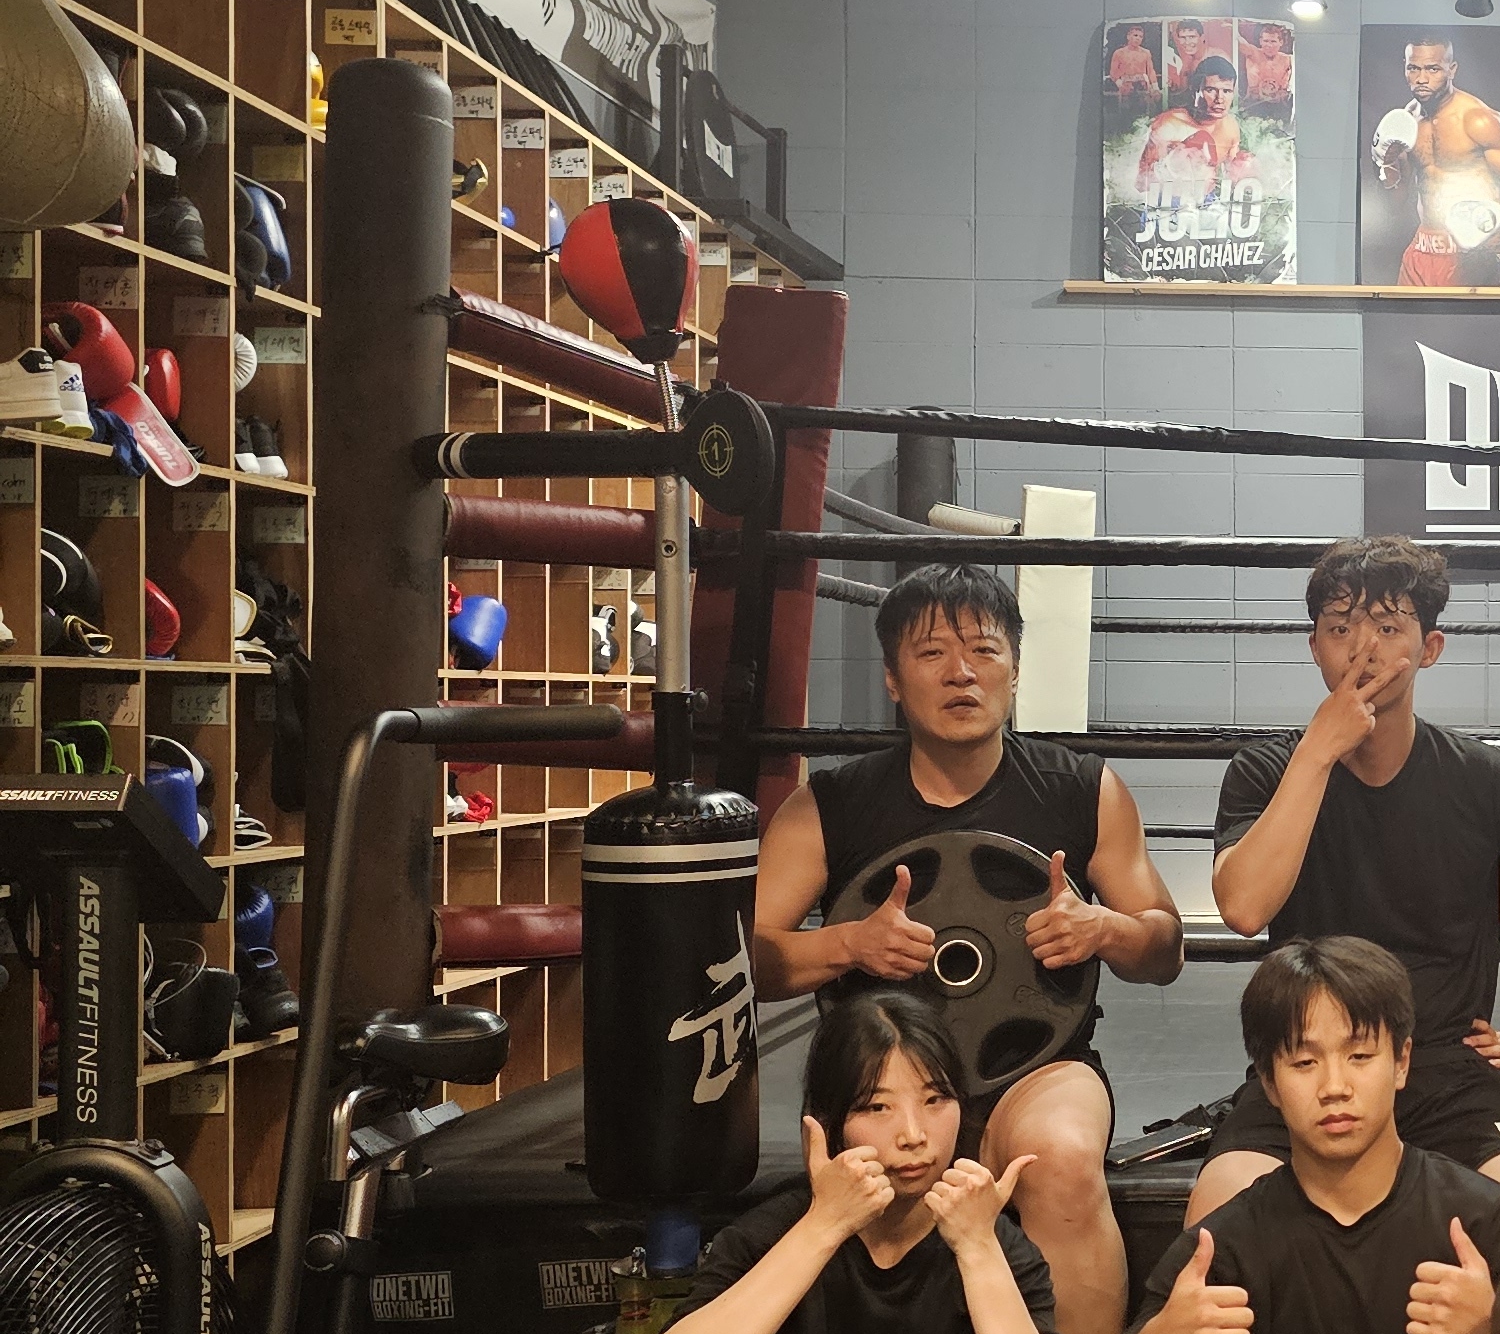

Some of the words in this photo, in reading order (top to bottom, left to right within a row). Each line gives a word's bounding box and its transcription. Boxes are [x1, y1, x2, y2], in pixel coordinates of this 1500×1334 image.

[1135, 177, 1263, 243] JULIO
[1142, 243, 1196, 272] CÉSAR
[1200, 238, 1265, 269] CHÁVEZ
[372, 1272, 451, 1302] ONETWO
[374, 1297, 451, 1319] BOXING-FIT
